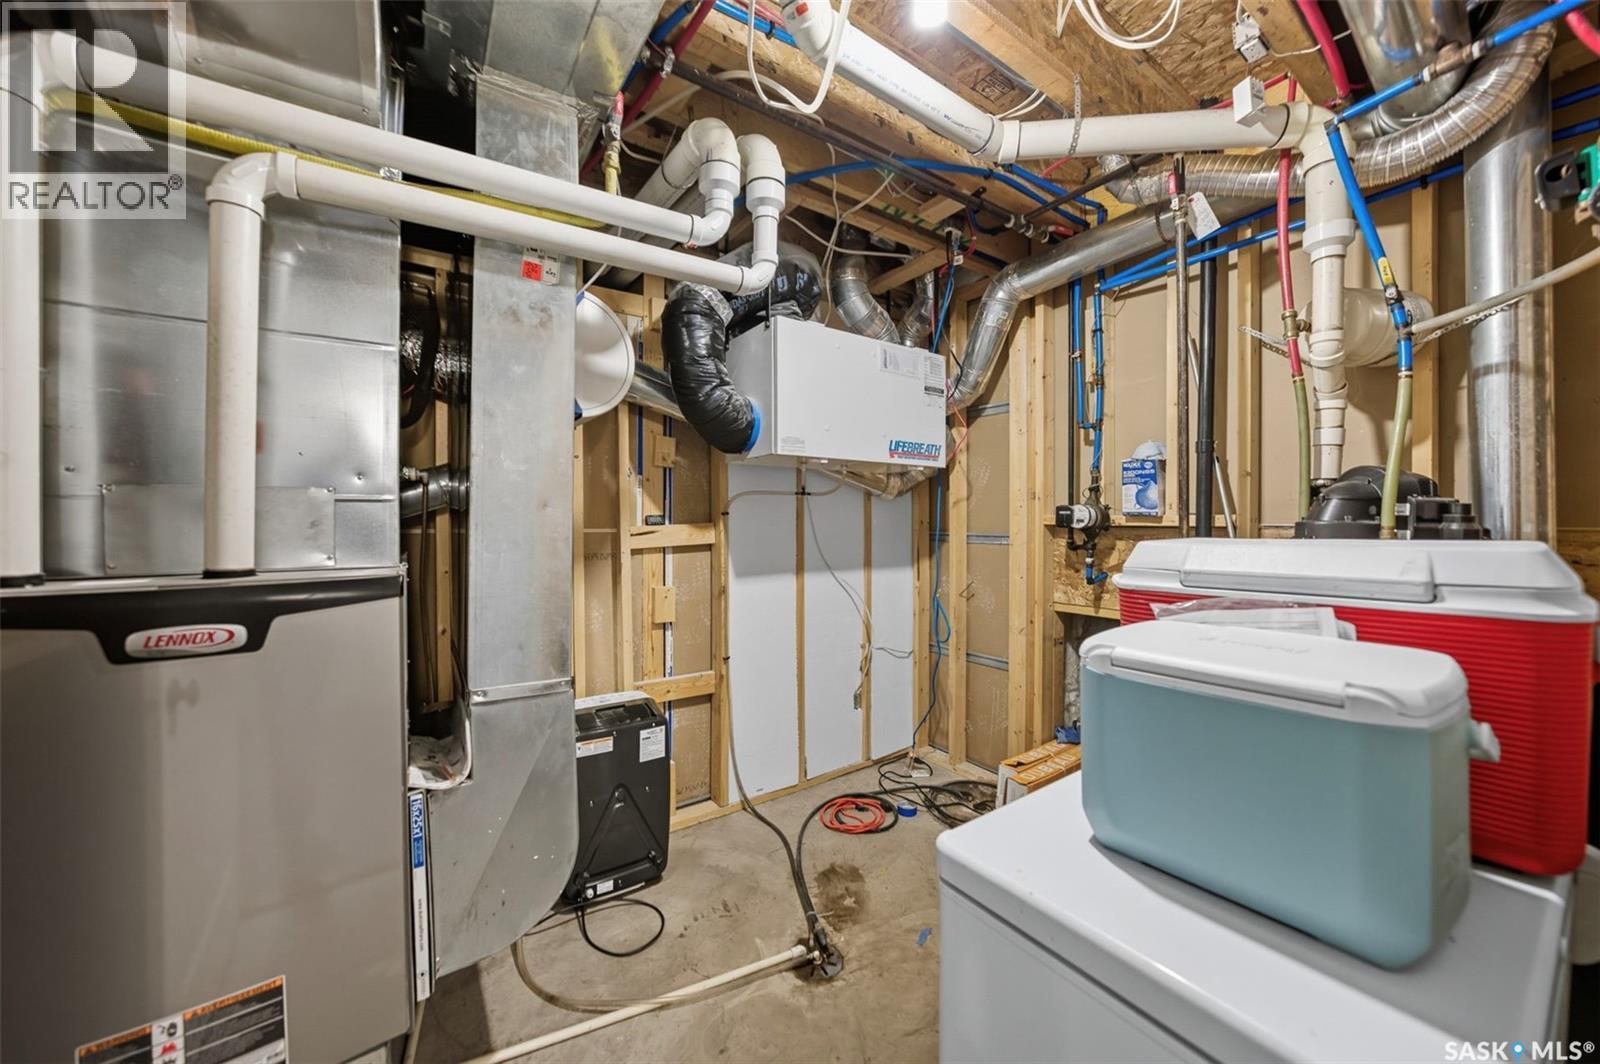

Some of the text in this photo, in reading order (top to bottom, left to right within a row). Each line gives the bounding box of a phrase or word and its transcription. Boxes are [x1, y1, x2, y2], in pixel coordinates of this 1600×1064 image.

[889, 439, 941, 456] LIFEBREATH
[143, 630, 216, 649] LENNOX
[412, 799, 423, 838] 16x25x1
